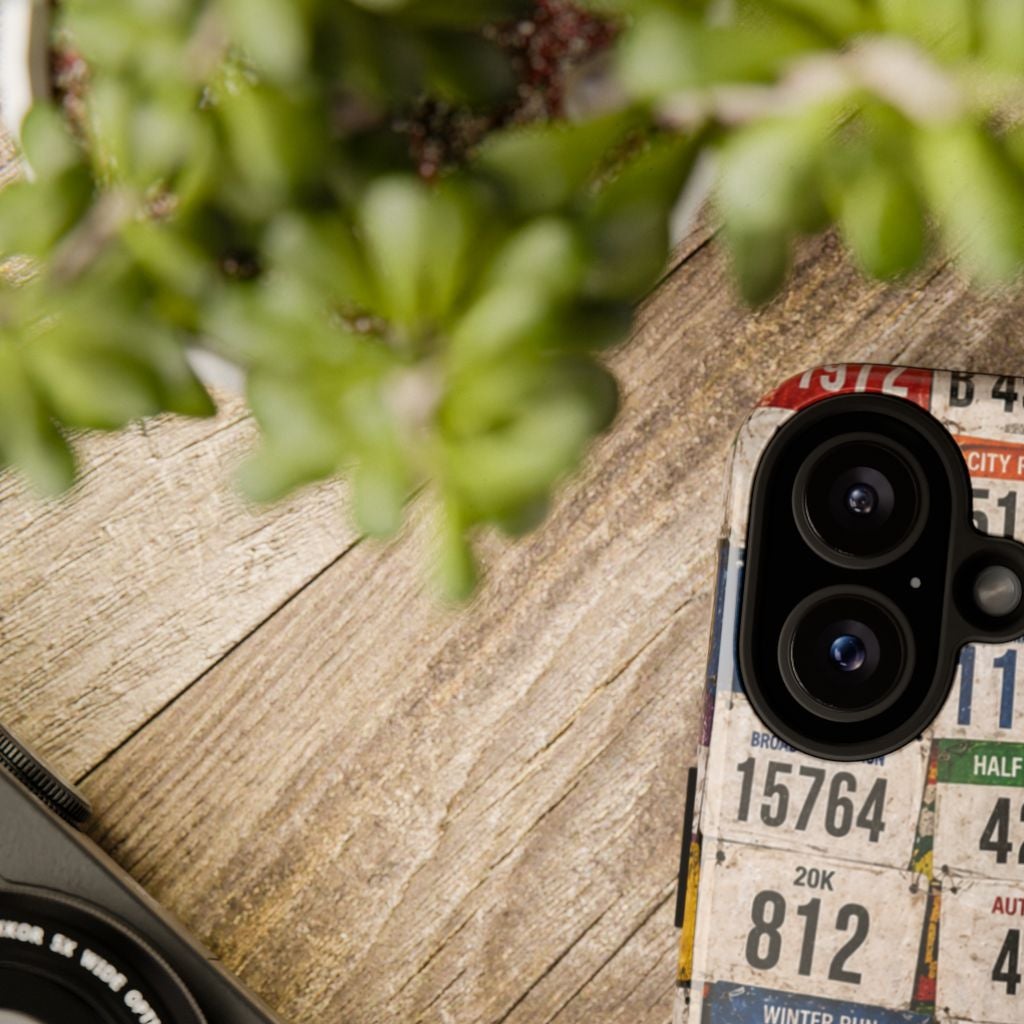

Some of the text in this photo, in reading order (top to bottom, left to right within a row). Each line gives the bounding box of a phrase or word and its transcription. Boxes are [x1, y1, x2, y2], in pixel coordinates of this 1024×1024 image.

[968, 451, 1011, 473] CITY
[973, 755, 1023, 779] HALF
[736, 757, 888, 843] 15764
[793, 866, 835, 891] 20K
[744, 890, 870, 985] 812
